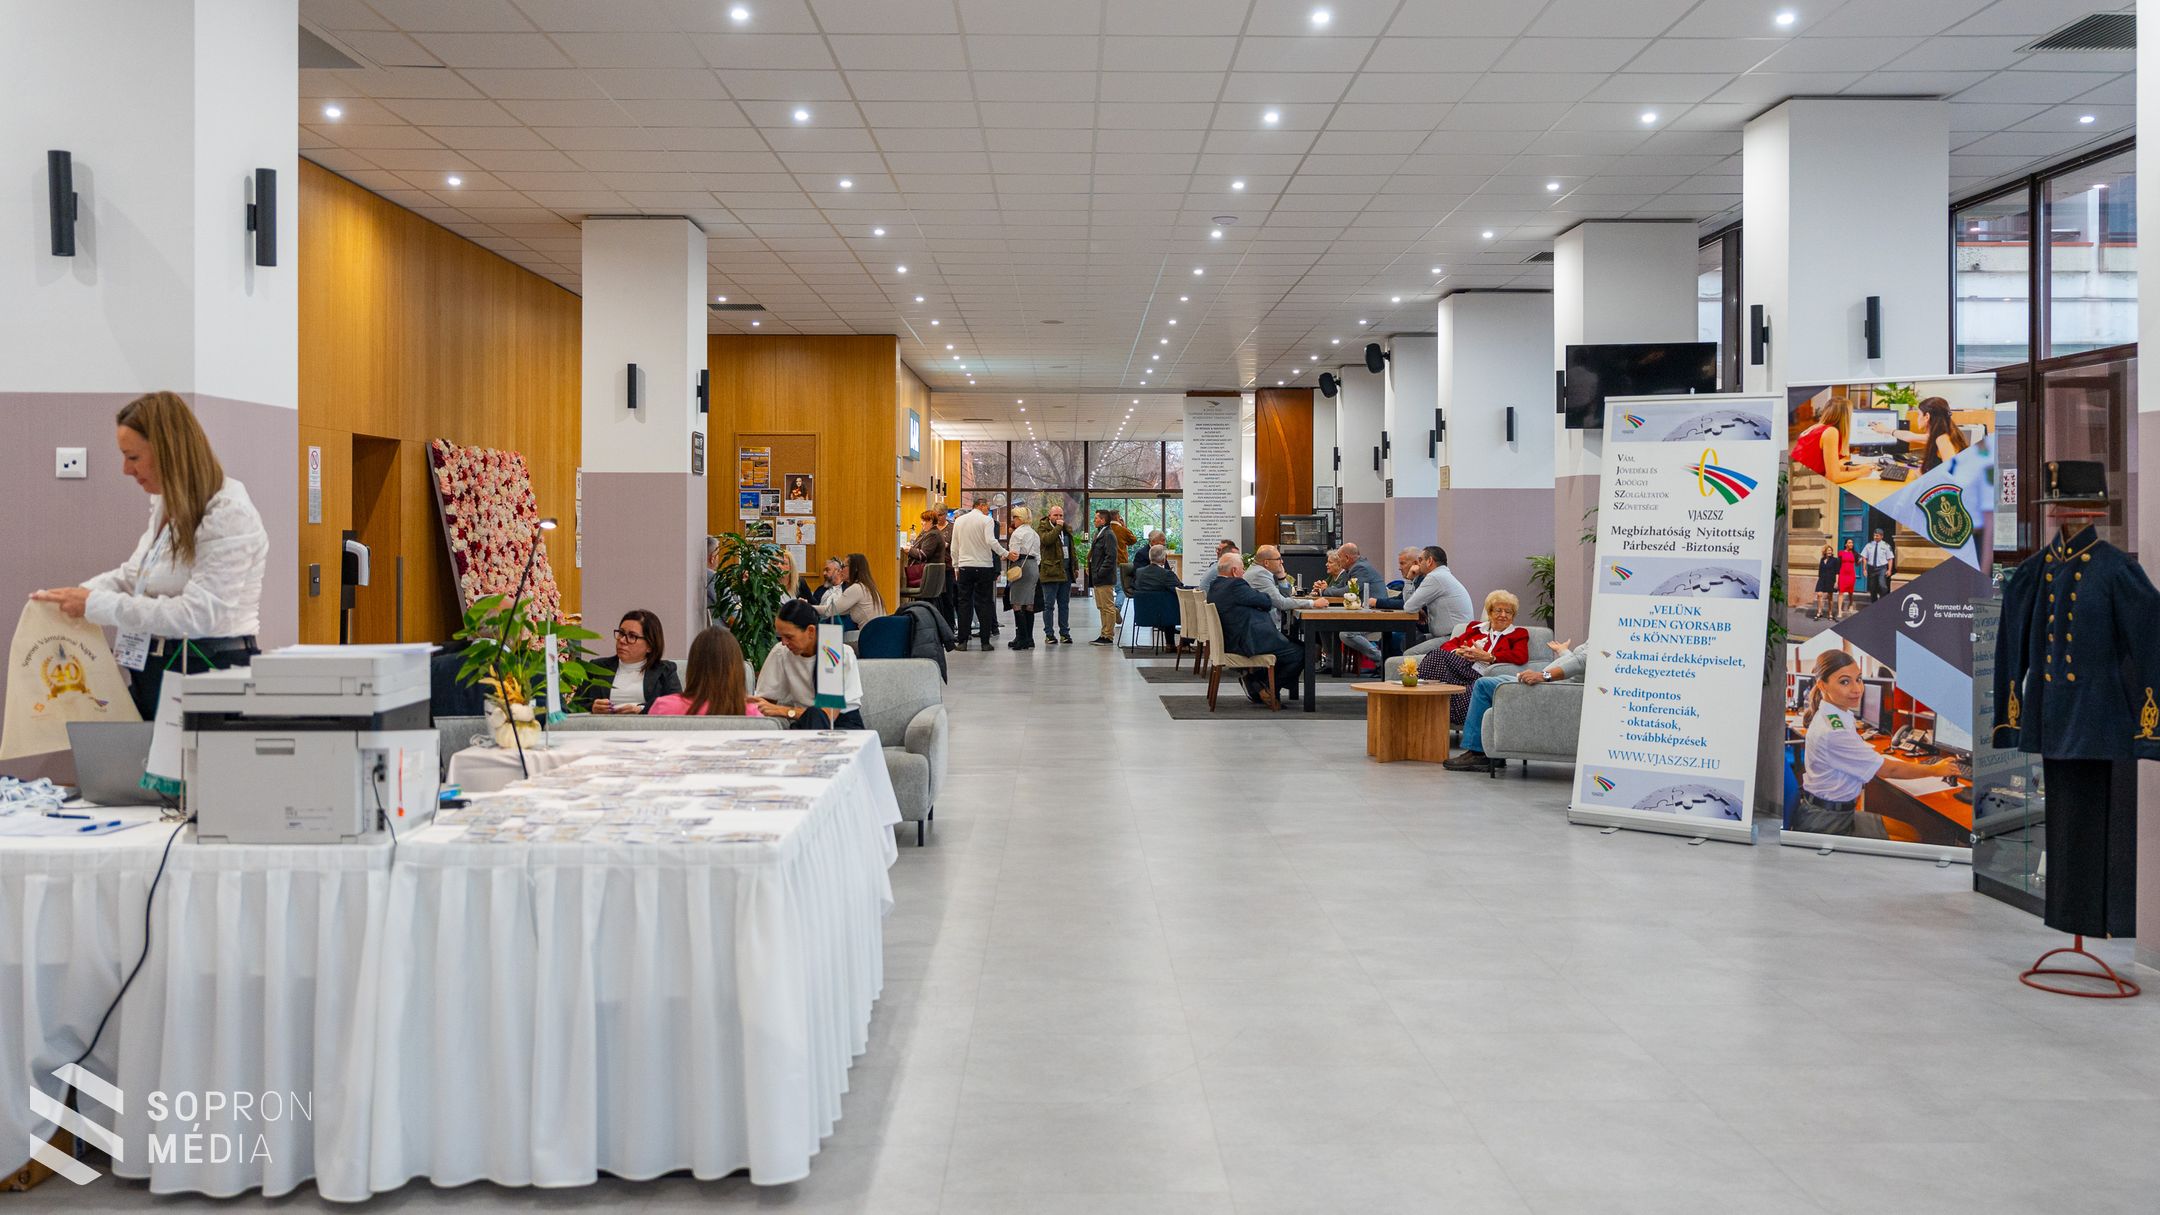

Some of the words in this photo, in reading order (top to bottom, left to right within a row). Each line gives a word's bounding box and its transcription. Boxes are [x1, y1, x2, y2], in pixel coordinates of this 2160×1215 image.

[1688, 510, 1724, 521] VJASZSZ
[1611, 525, 1691, 538] Megbízhatóság
[1696, 527, 1755, 540] Nyitottság
[1623, 540, 1676, 552] Párbeszéd
[1934, 603, 1961, 611] Nemzeti
[1618, 617, 1667, 629] MINDEN
[1669, 620, 1732, 632] GYORSABB
[1630, 632, 1641, 642] és
[1615, 649, 1659, 661] Szakmai
[1661, 652, 1746, 668] érdekképviselet,
[50, 663, 80, 682] 40
[1614, 663, 1696, 678] érdekegyeztetés
[1613, 686, 1682, 701] Kreditpontos
[1628, 701, 1700, 718] konferenciák,
[1627, 717, 1681, 731] oktatások,
[1626, 732, 1708, 747] továbbképzések
[1608, 749, 1721, 770] WWW.VJASZSZ.HU
